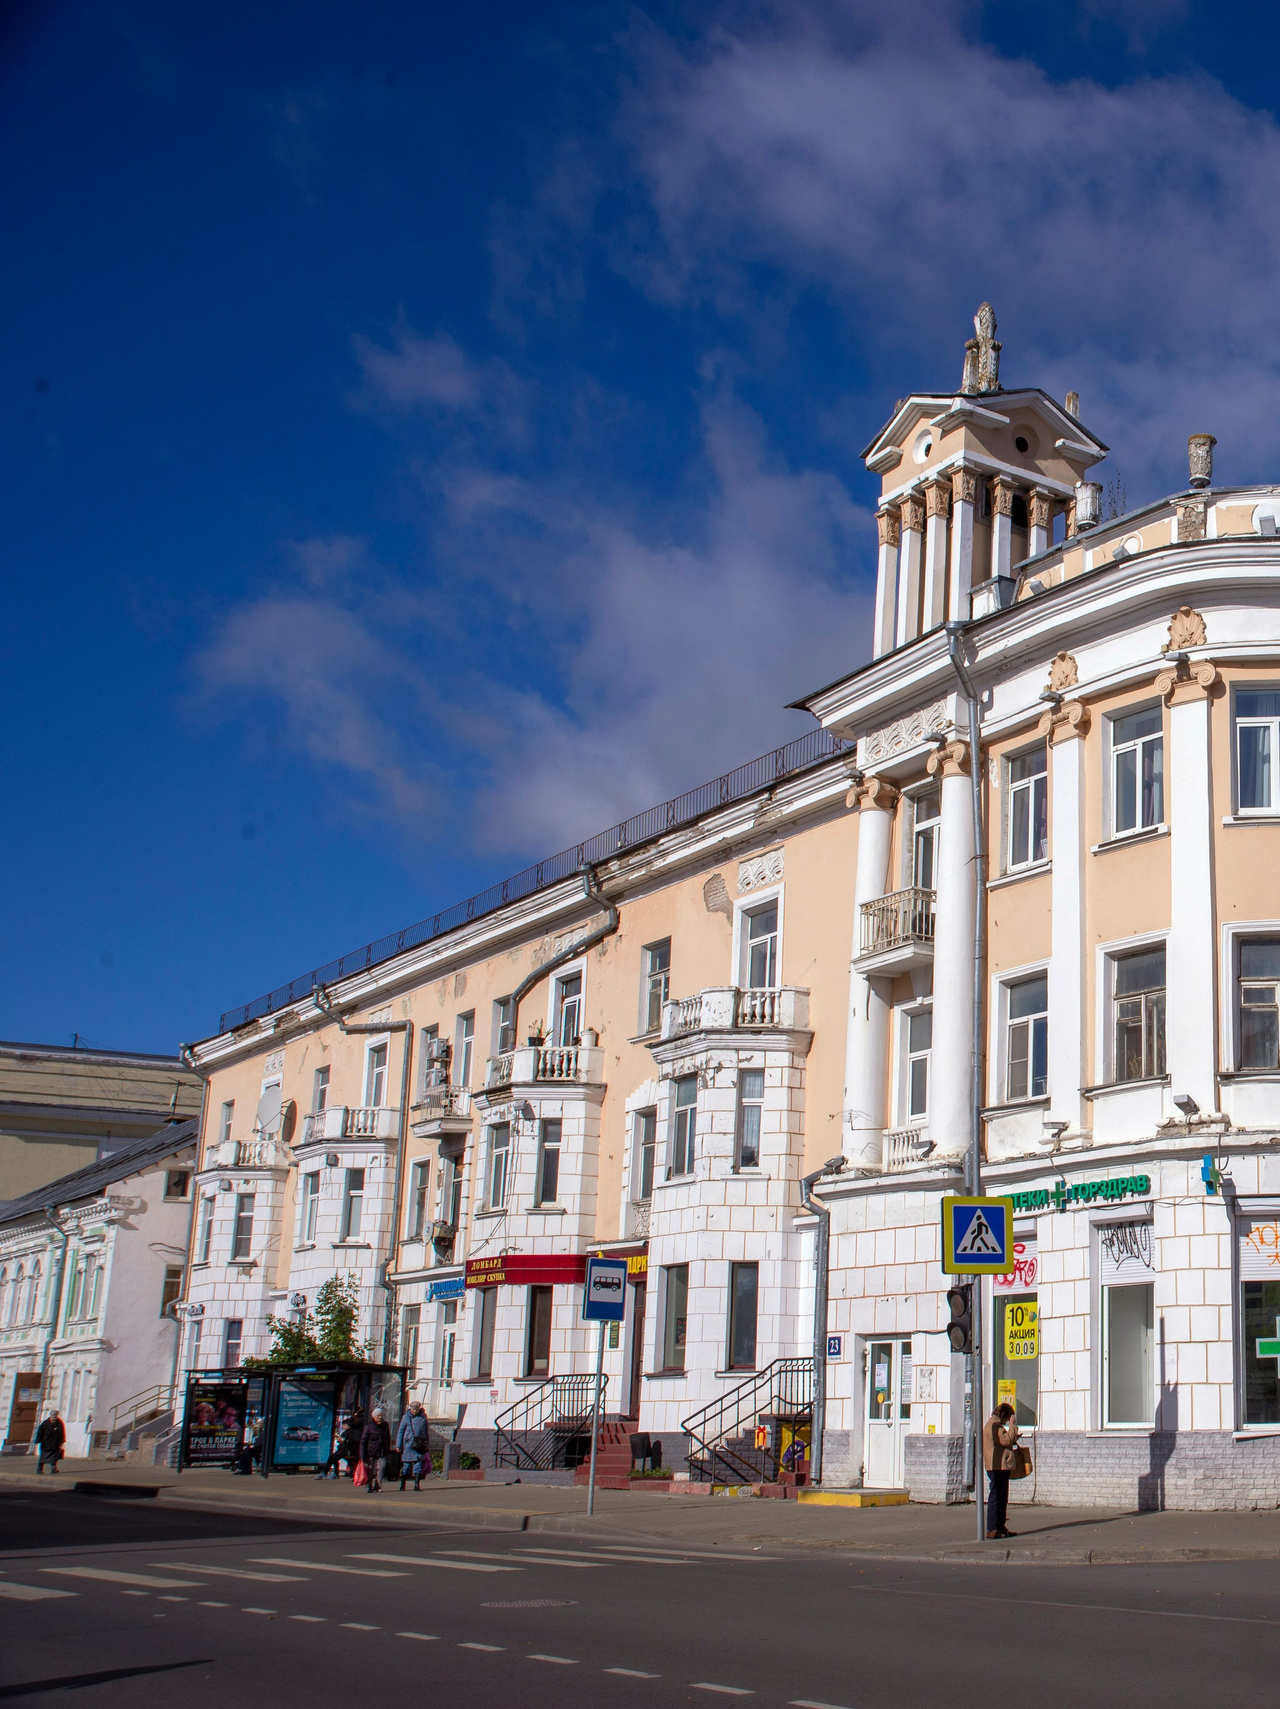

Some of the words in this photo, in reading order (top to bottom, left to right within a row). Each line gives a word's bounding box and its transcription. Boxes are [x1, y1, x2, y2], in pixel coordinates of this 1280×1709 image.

[998, 1189, 1048, 1208] ТЕКИ
[1071, 1175, 1149, 1200] ГОРЗДРАВ
[471, 1258, 502, 1271] ЛОМБАРД
[466, 1273, 486, 1285] ЮВЕЛИР
[487, 1272, 506, 1282] СКУПКА
[1009, 1328, 1035, 1340] АКЦИЯ
[829, 1339, 839, 1353] 23
[1009, 1341, 1035, 1356] 30.09
